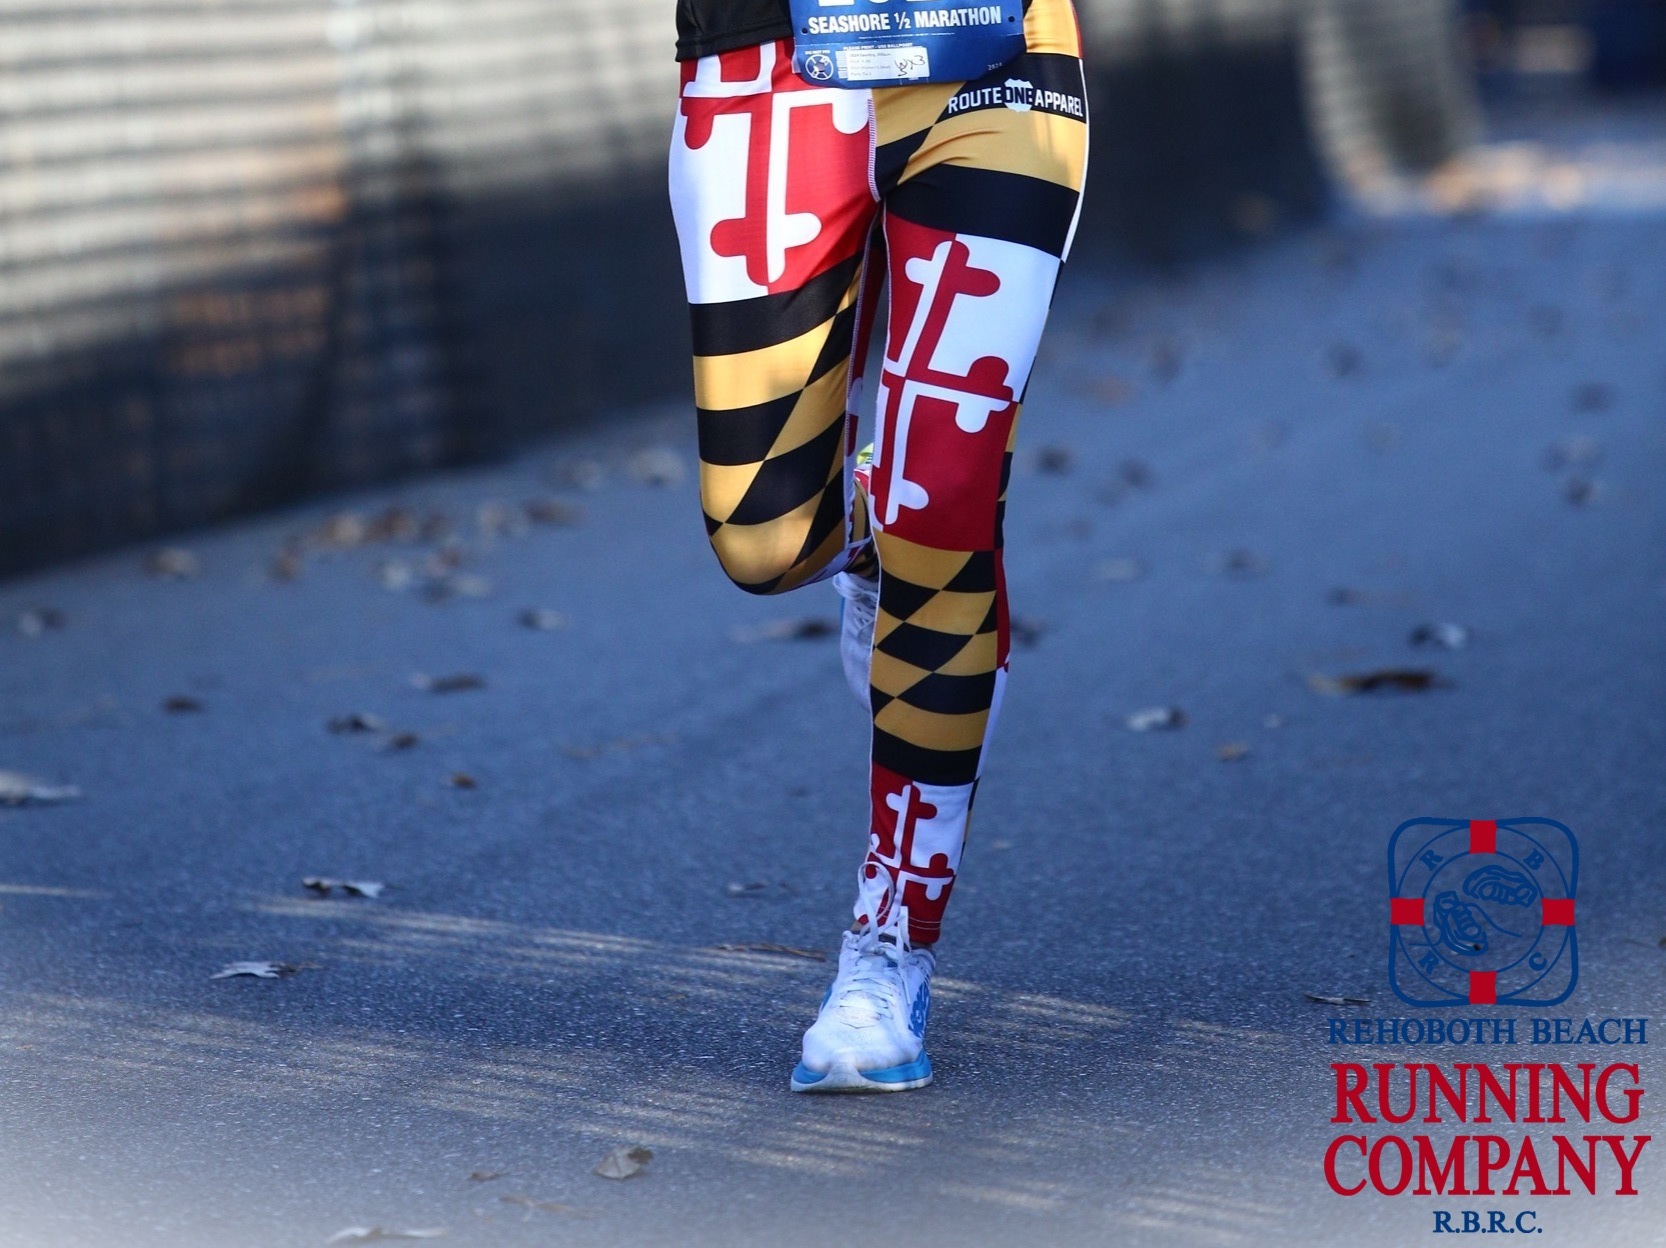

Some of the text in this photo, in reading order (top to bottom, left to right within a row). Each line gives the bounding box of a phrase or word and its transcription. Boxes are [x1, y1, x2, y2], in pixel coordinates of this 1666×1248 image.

[808, 13, 890, 35] SEASHORE
[915, 5, 1002, 29] MARATHON
[948, 86, 1084, 117] ROUTE ONE APPAREL
